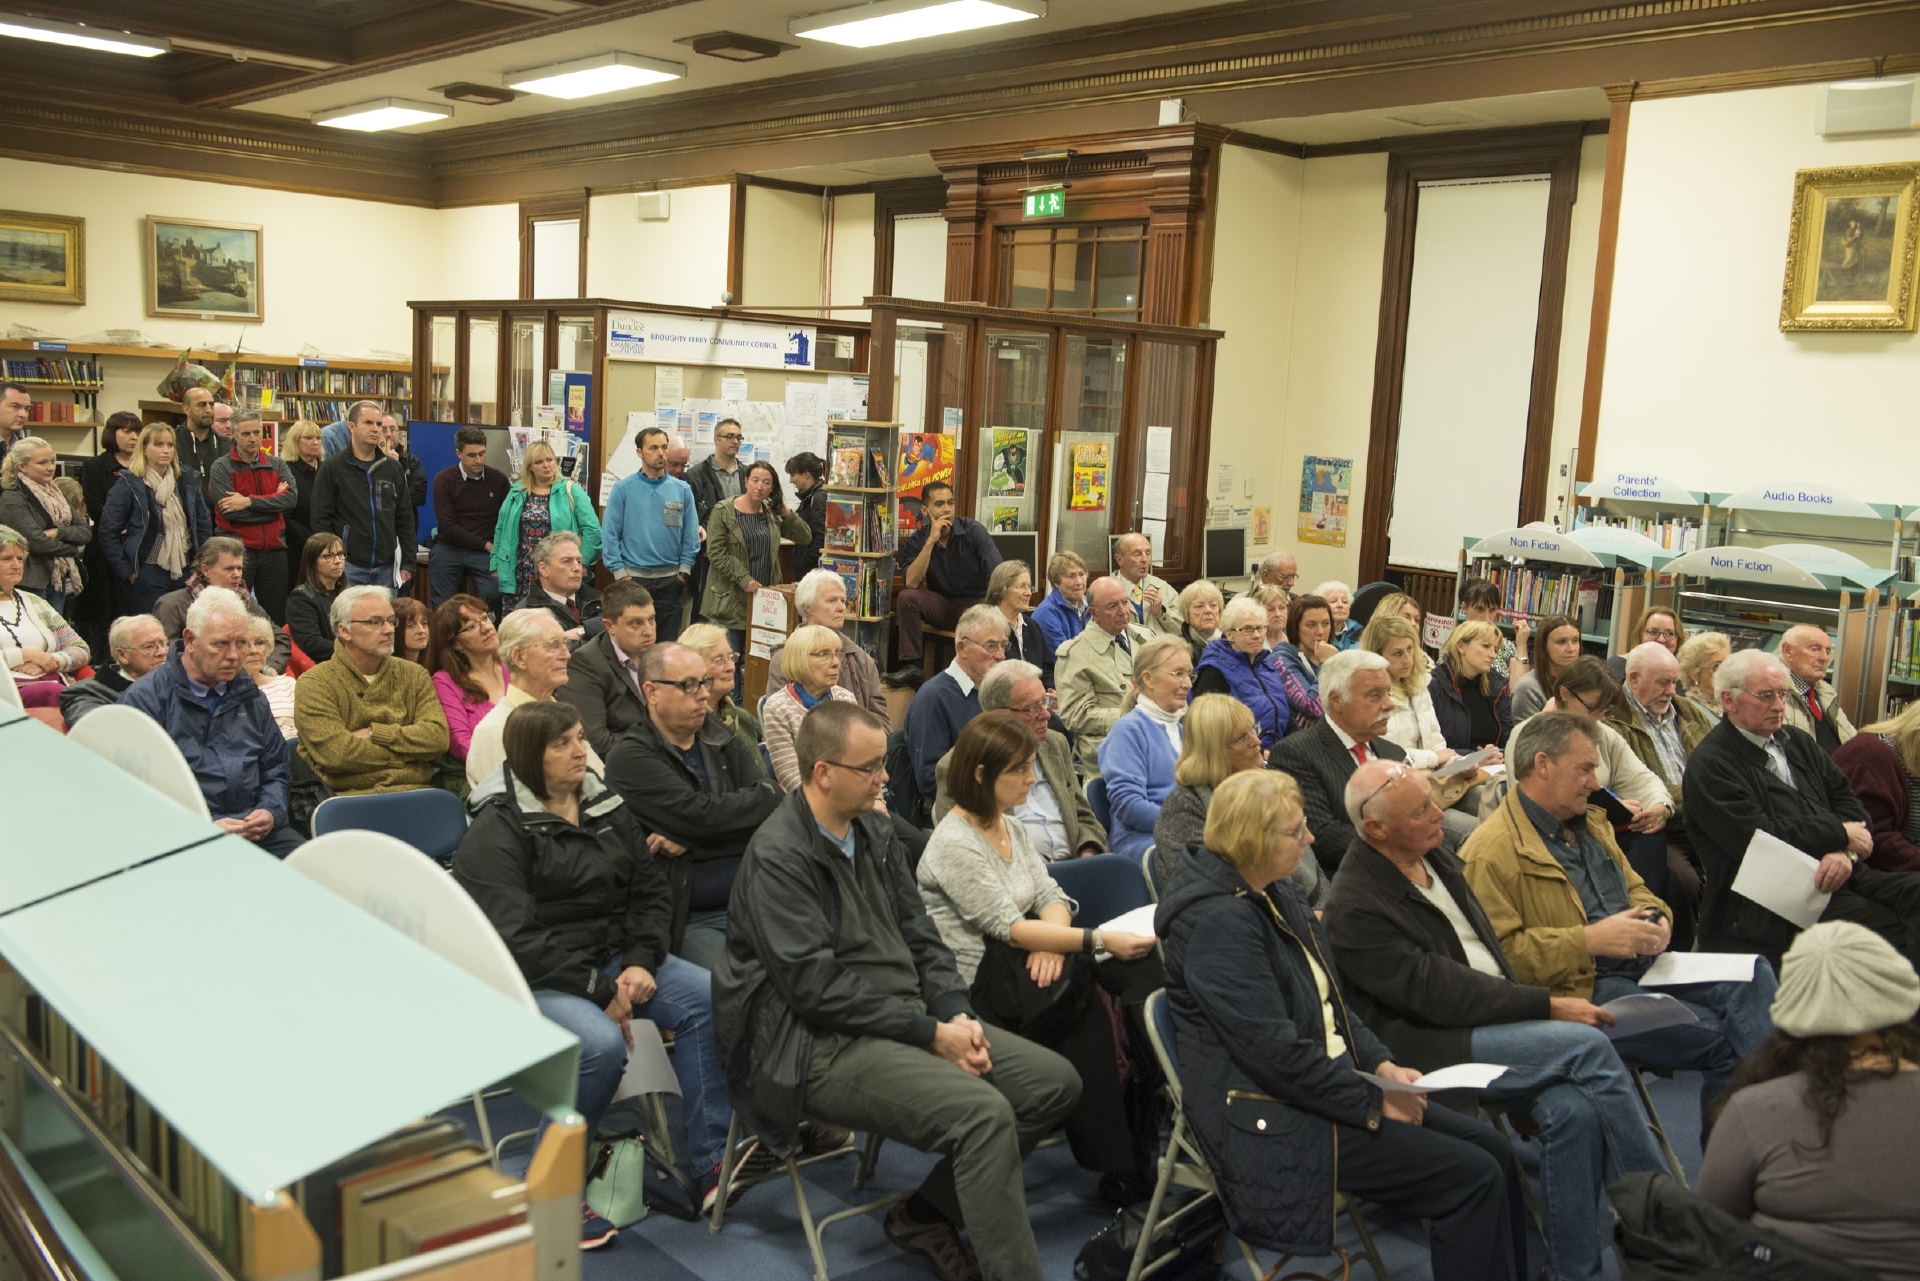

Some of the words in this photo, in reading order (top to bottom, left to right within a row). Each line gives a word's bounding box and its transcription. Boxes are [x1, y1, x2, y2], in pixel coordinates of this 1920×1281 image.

[611, 320, 645, 331] Dundee
[610, 341, 645, 350] CHANGING
[651, 333, 687, 342] BROUGHTY
[688, 336, 708, 344] FERRY
[709, 337, 750, 347] COMMUNITY
[750, 341, 778, 350] COUNCIL
[620, 346, 645, 355] FUTURE
[932, 467, 953, 482] POWER
[1617, 474, 1658, 486] Parents'
[1613, 486, 1661, 498] Collection
[1762, 489, 1795, 502] Audio
[1798, 492, 1833, 504] Books
[1510, 536, 1529, 548] Non
[1531, 539, 1560, 551] Fiction
[1710, 555, 1733, 568] Non
[1737, 558, 1773, 572] Fiction
[760, 590, 780, 600] BOOKS
[761, 605, 778, 615] SALE
